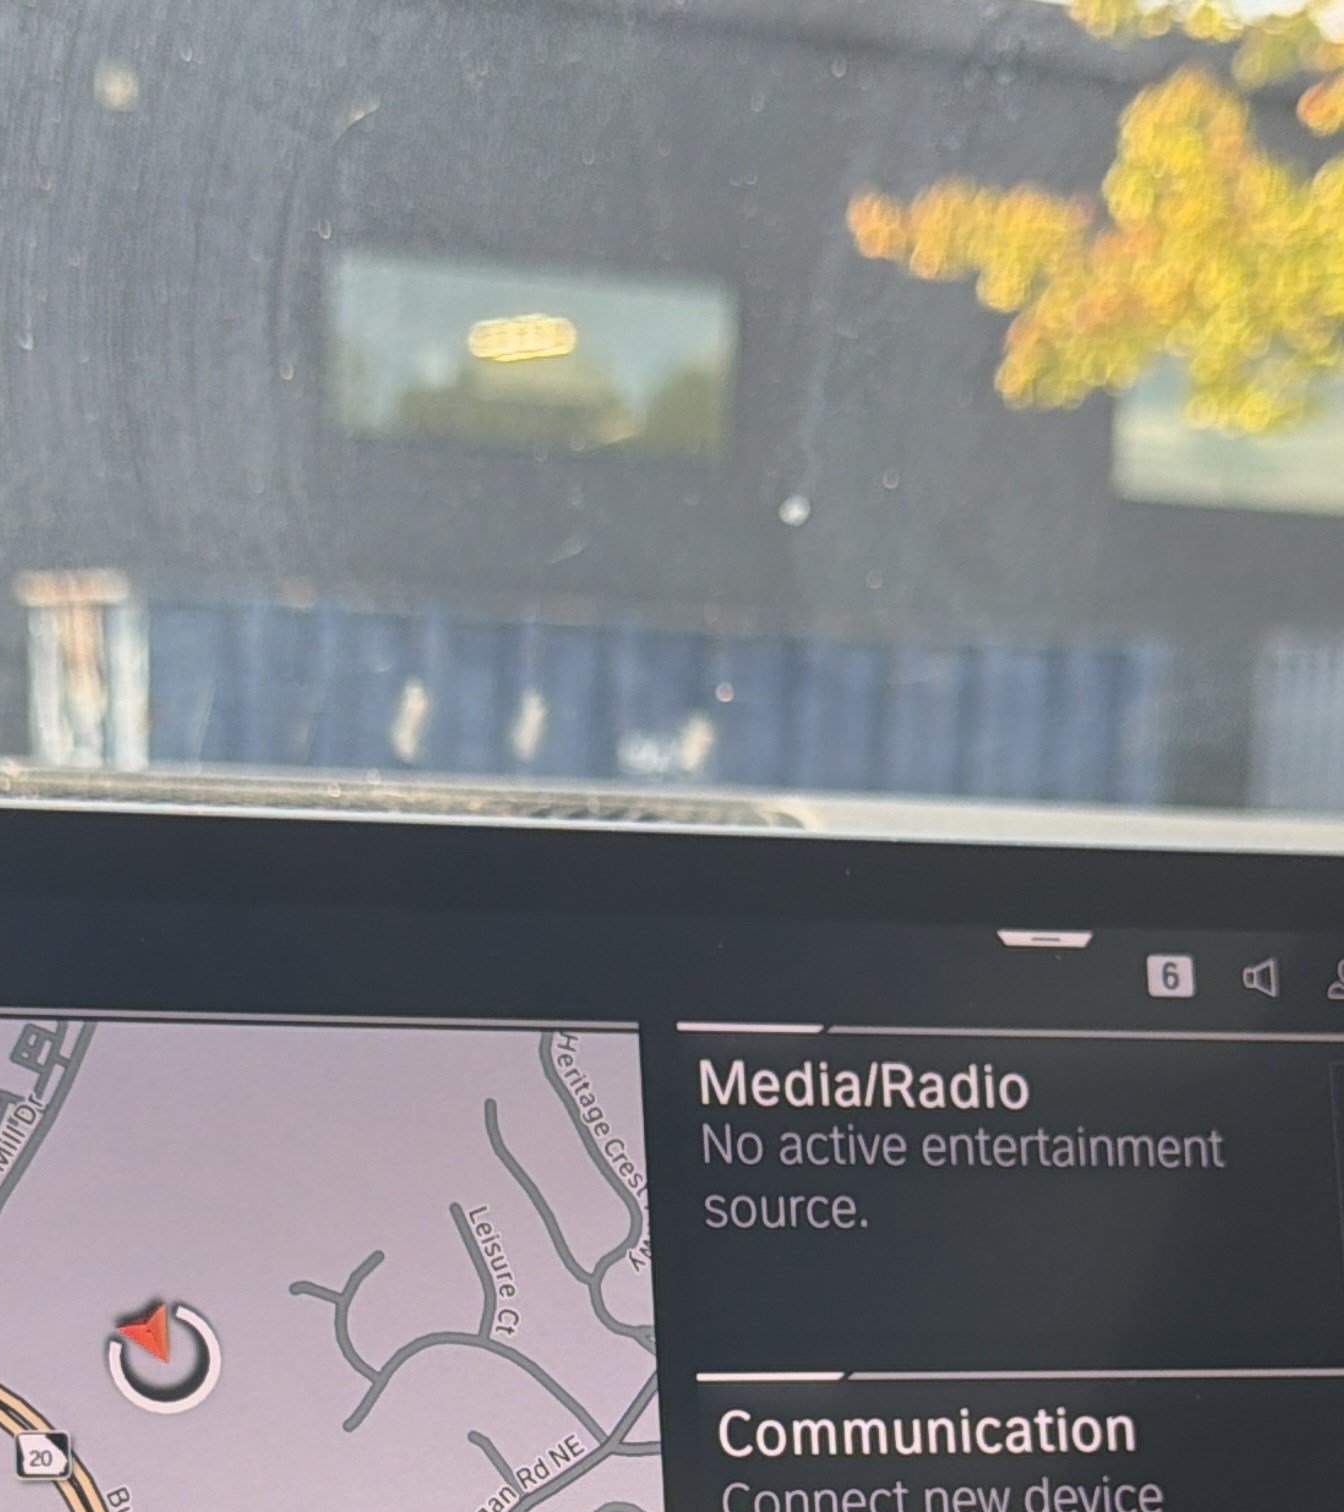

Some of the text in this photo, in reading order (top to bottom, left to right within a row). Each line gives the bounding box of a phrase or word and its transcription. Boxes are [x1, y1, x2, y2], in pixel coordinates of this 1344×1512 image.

[1161, 961, 1180, 990] 6
[557, 1031, 610, 1136] Heritage
[699, 1060, 1029, 1109] Media/Radio
[14, 1093, 43, 1125] Dr
[702, 1124, 1225, 1168] No active entertainment
[704, 1194, 869, 1228] source.
[468, 1205, 519, 1335] Leisure Ct
[718, 1407, 1136, 1458] Communication
[29, 1451, 52, 1467] 20
[516, 1460, 551, 1489] Rd
[549, 1435, 586, 1468] NE
